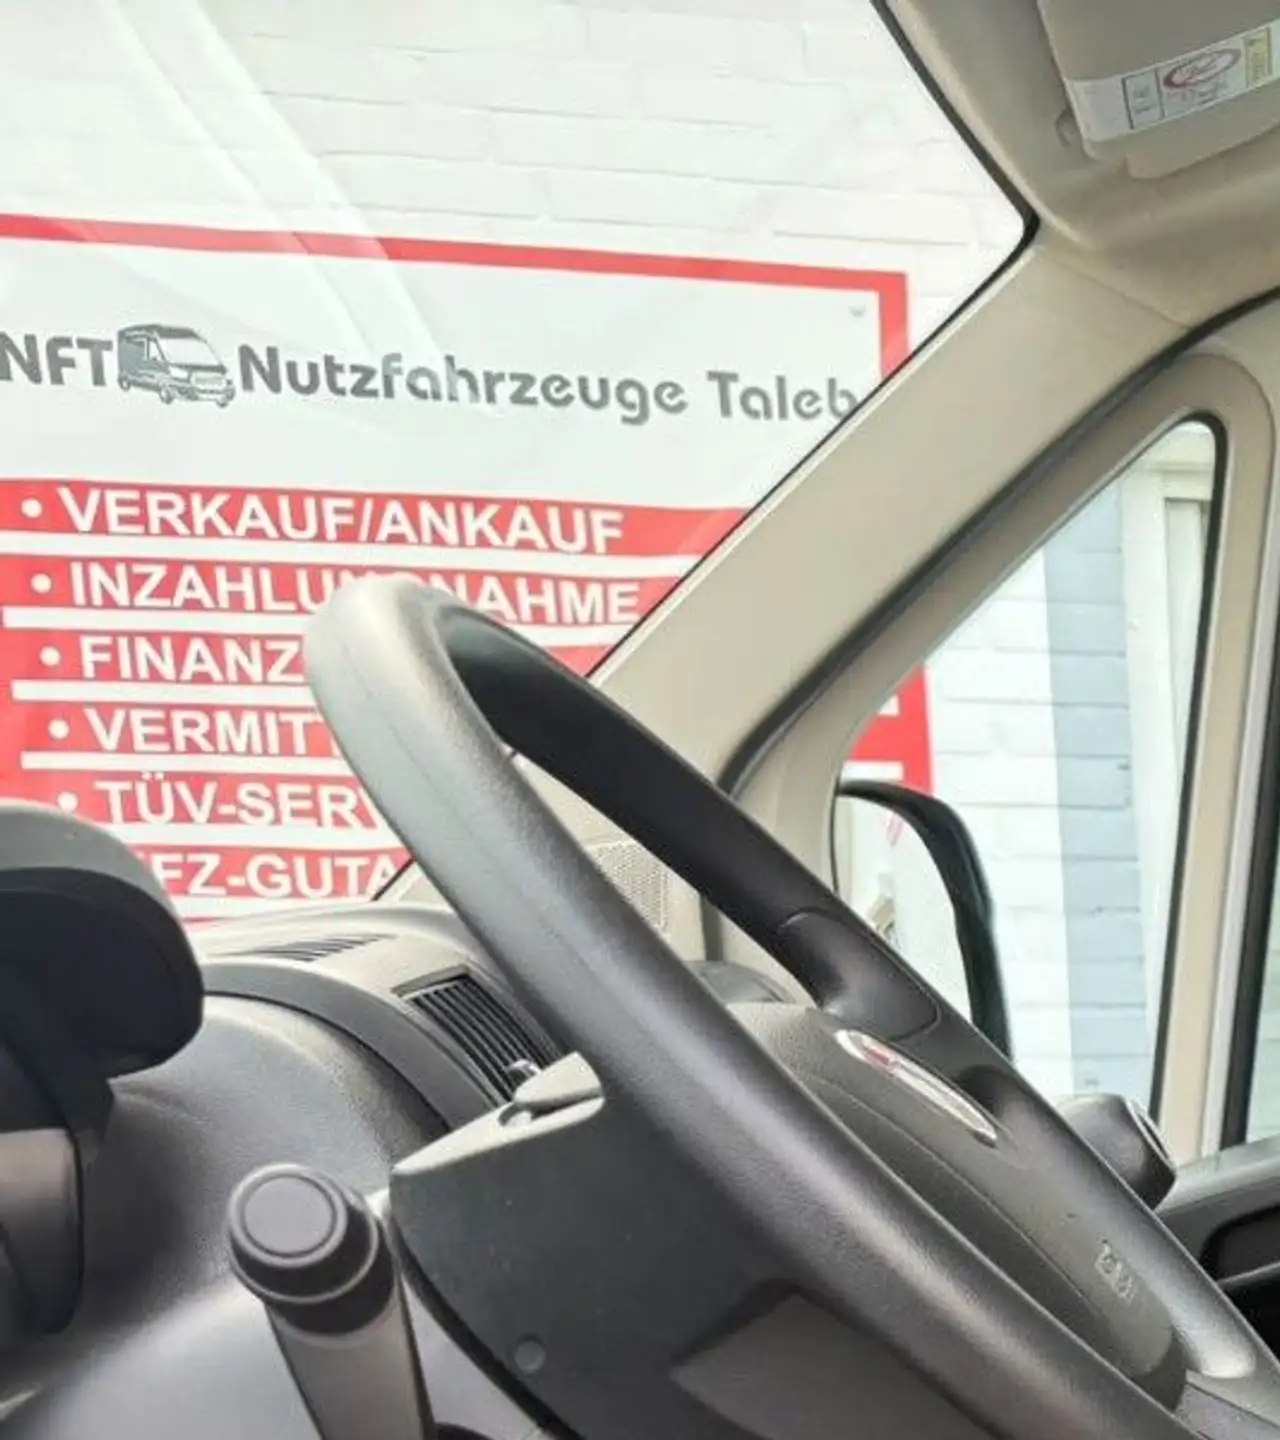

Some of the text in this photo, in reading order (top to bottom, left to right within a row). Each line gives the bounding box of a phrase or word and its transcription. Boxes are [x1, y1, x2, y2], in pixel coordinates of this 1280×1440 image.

[0, 331, 114, 387] NFT
[238, 344, 688, 426] Nutzfahrzeuge
[57, 486, 624, 554] VERKAUF/ANKAUF
[70, 561, 641, 625] INZAHLUNAHME
[84, 708, 342, 757] VERMIT
[136, 851, 399, 898] FZ-GUTA
